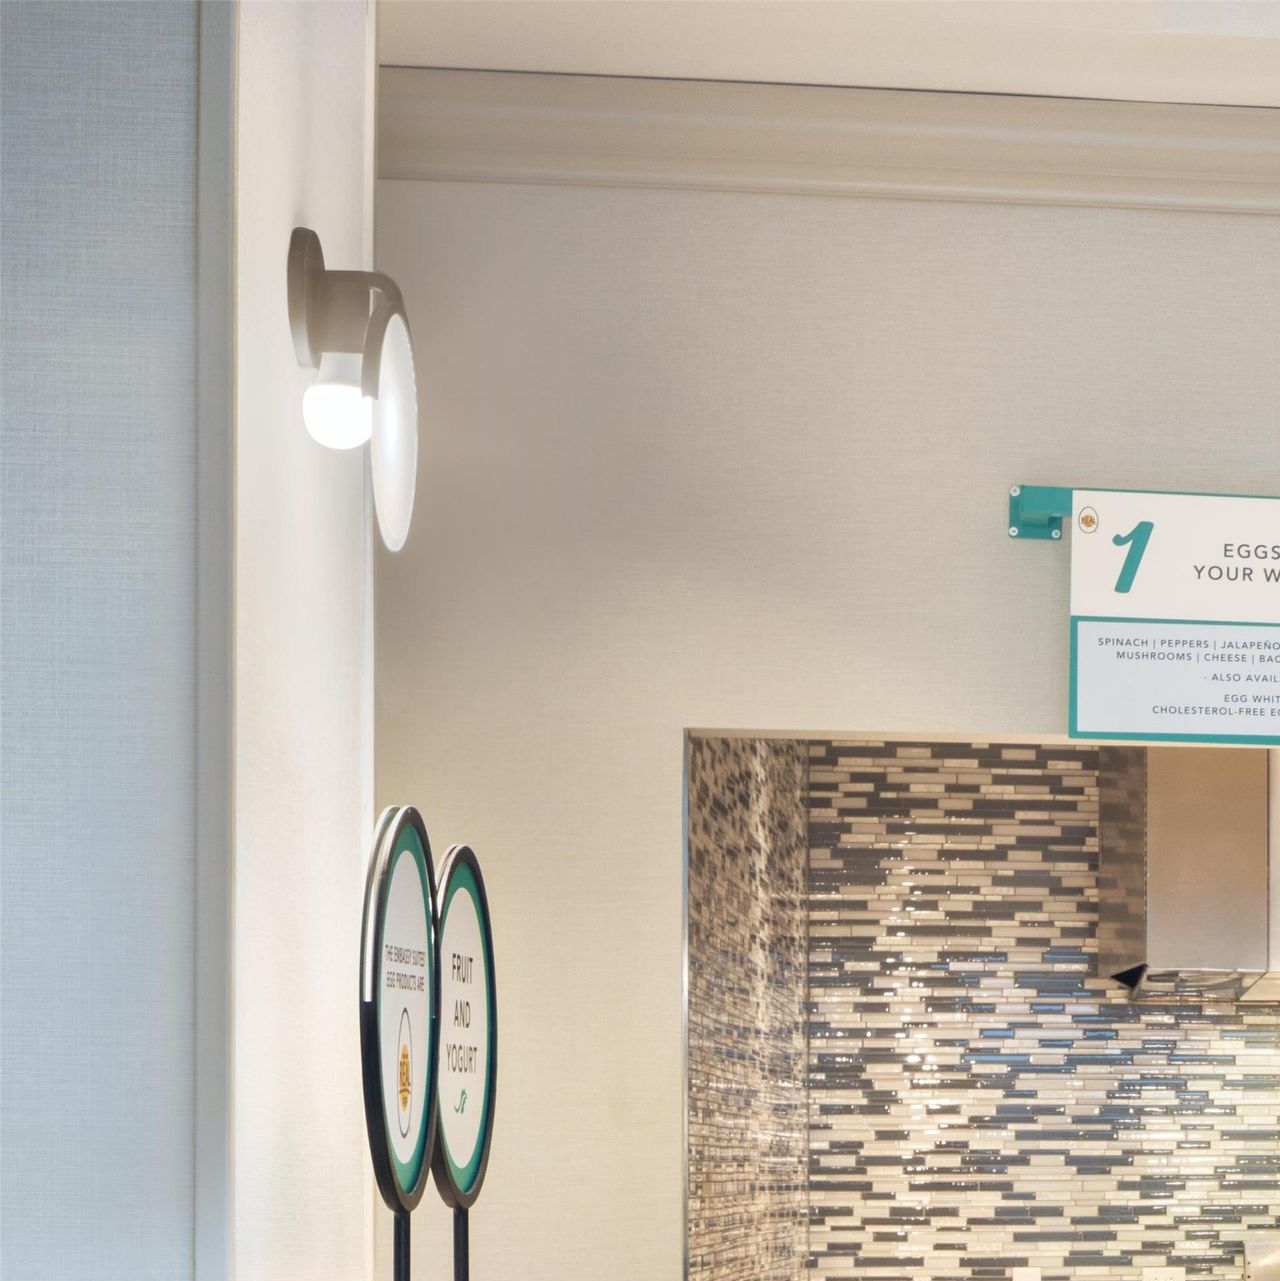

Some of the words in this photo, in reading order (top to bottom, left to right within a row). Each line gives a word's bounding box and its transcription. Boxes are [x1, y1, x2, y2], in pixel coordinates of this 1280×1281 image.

[1112, 520, 1154, 594] 1
[1223, 543, 1280, 560] EGGS
[1194, 565, 1253, 582] YOUR
[1098, 637, 1148, 647] SPINACH
[1160, 639, 1209, 649] PEPPERS
[1116, 651, 1192, 661] MUSHROOMS
[1203, 653, 1247, 663] CHEESE
[1211, 673, 1241, 682] ALSO
[1224, 694, 1248, 703] EGG
[1152, 705, 1265, 717] CHOLESTEROL-FREE
[452, 953, 473, 984] FRUIT
[454, 999, 471, 1028] AND
[446, 1043, 477, 1073] YOGURT
